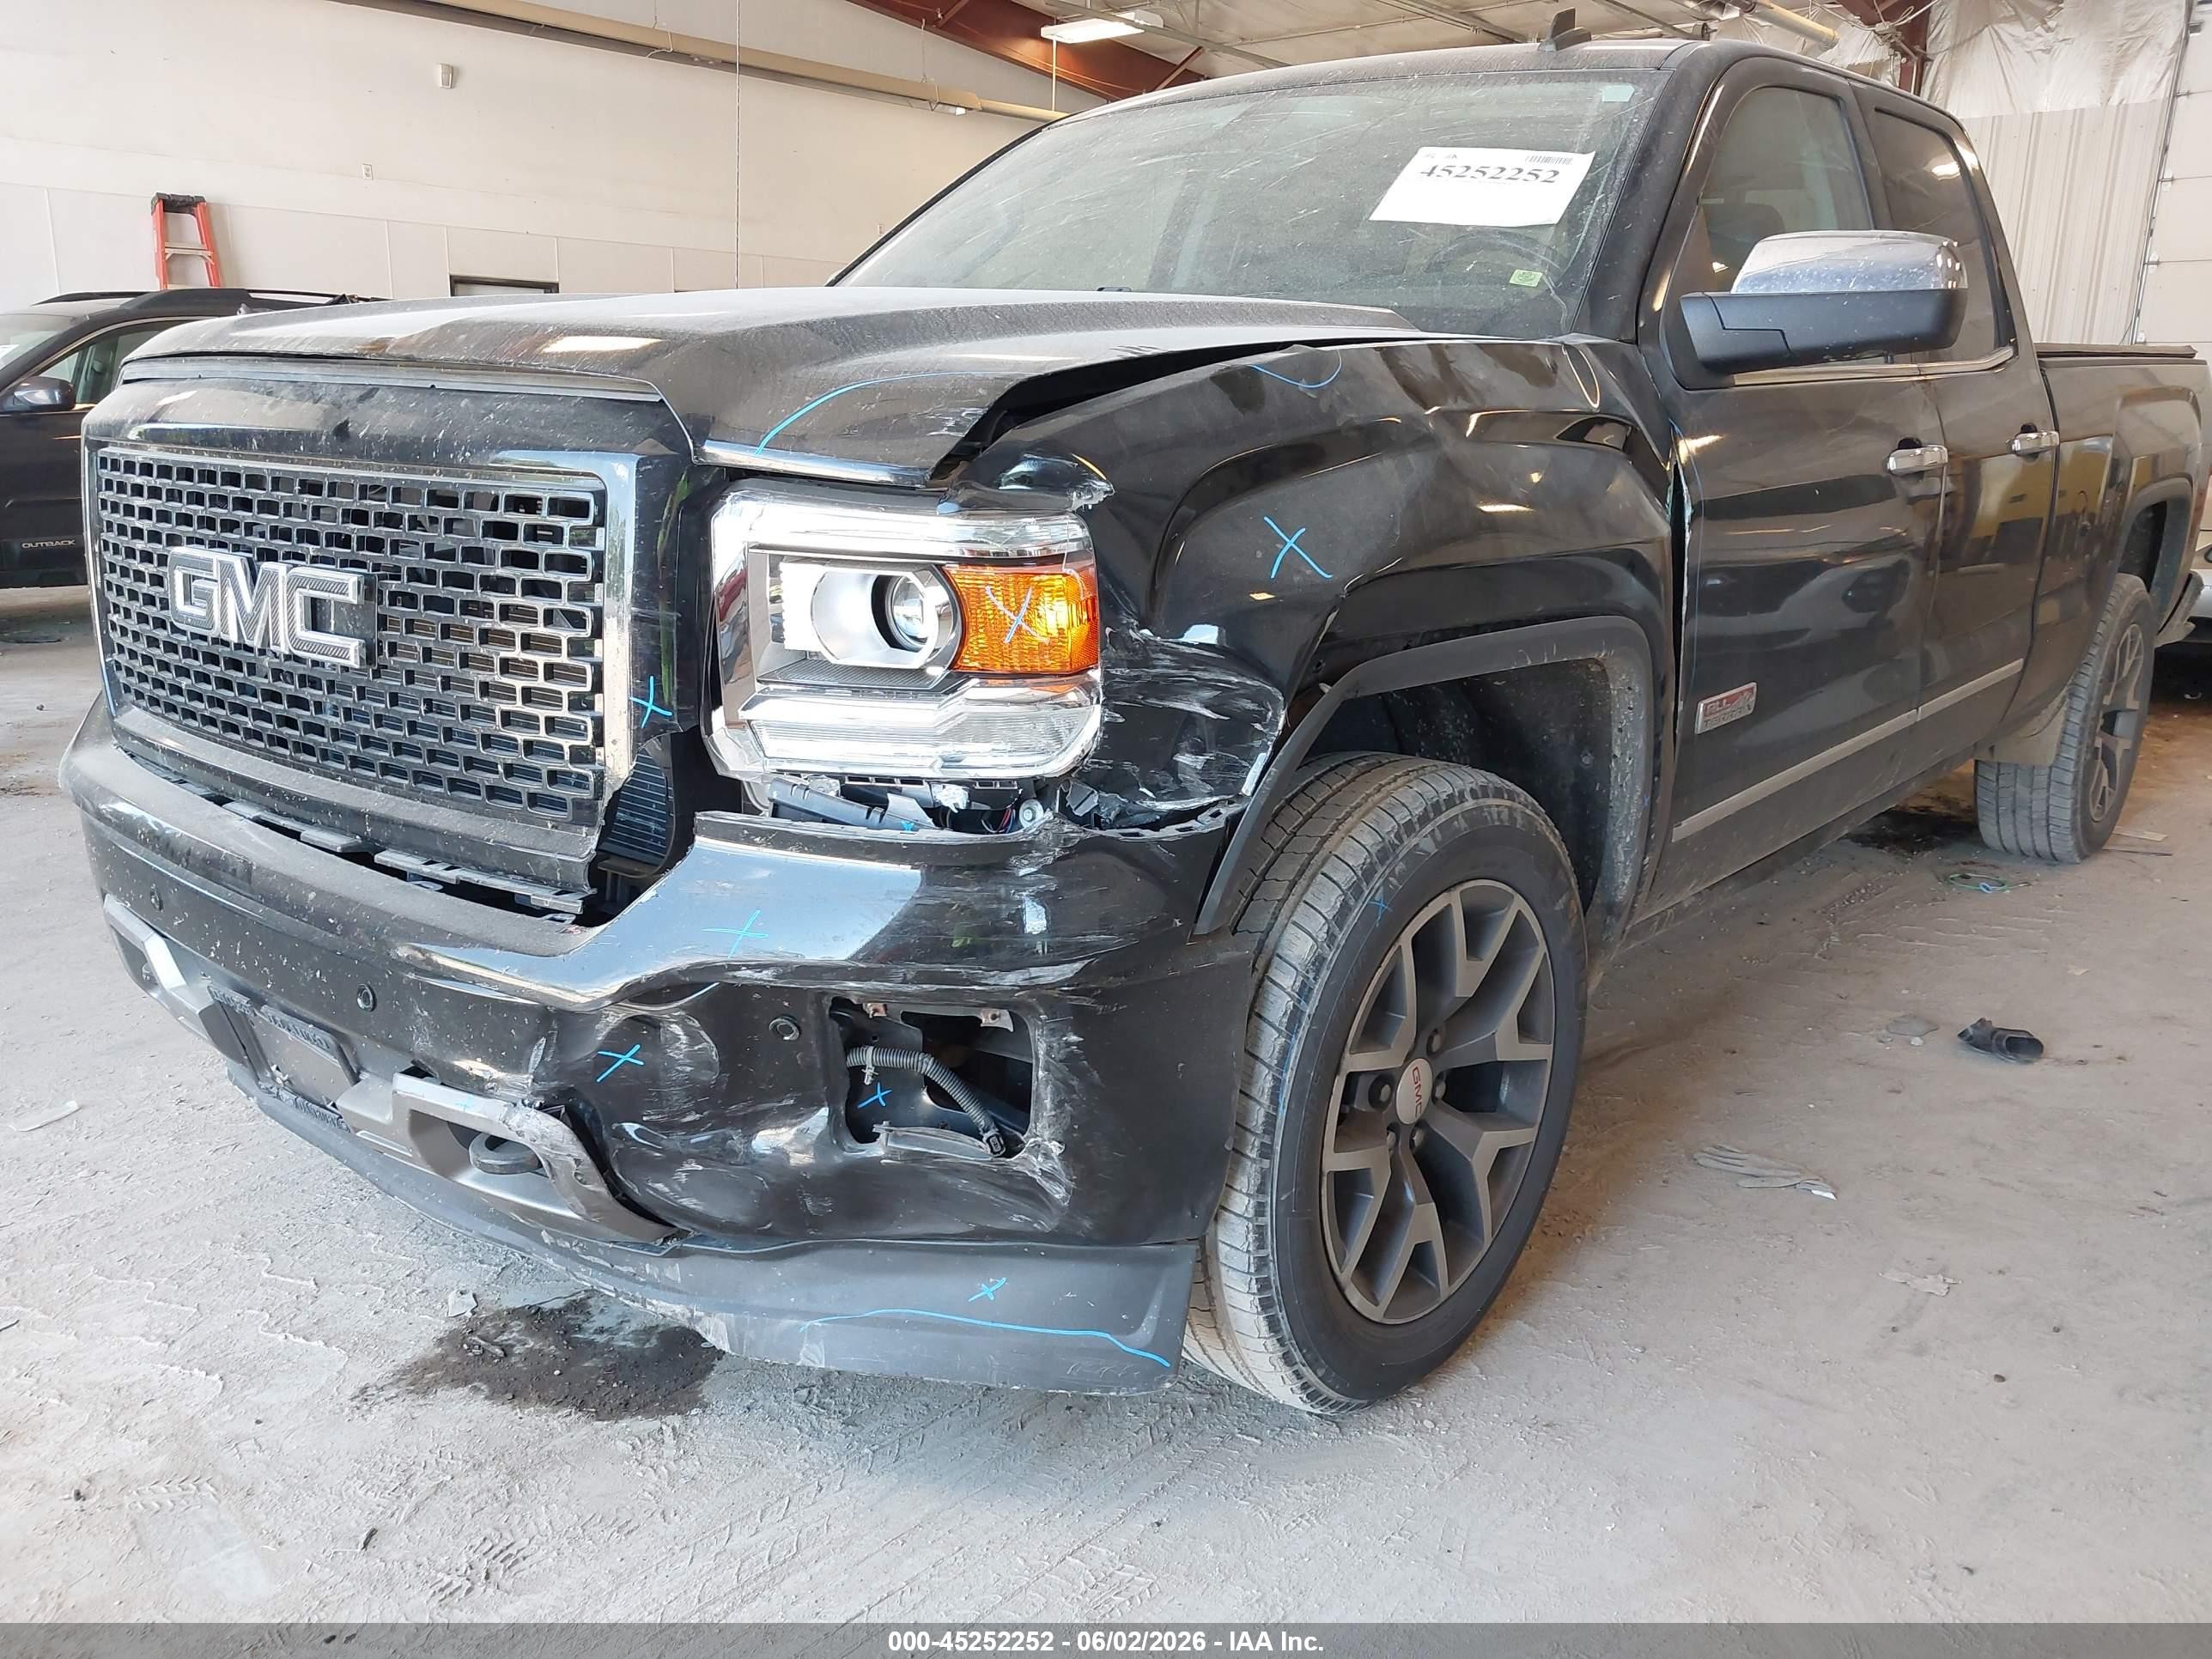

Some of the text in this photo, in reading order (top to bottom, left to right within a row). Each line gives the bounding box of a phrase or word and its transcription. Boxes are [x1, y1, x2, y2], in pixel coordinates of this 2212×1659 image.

[1419, 164, 1560, 184] 45252252
[21, 539, 76, 550] OUTBACK
[167, 545, 367, 669] GMC
[1703, 704, 1753, 727] TERRAN
[1412, 1066, 1423, 1118] GMC
